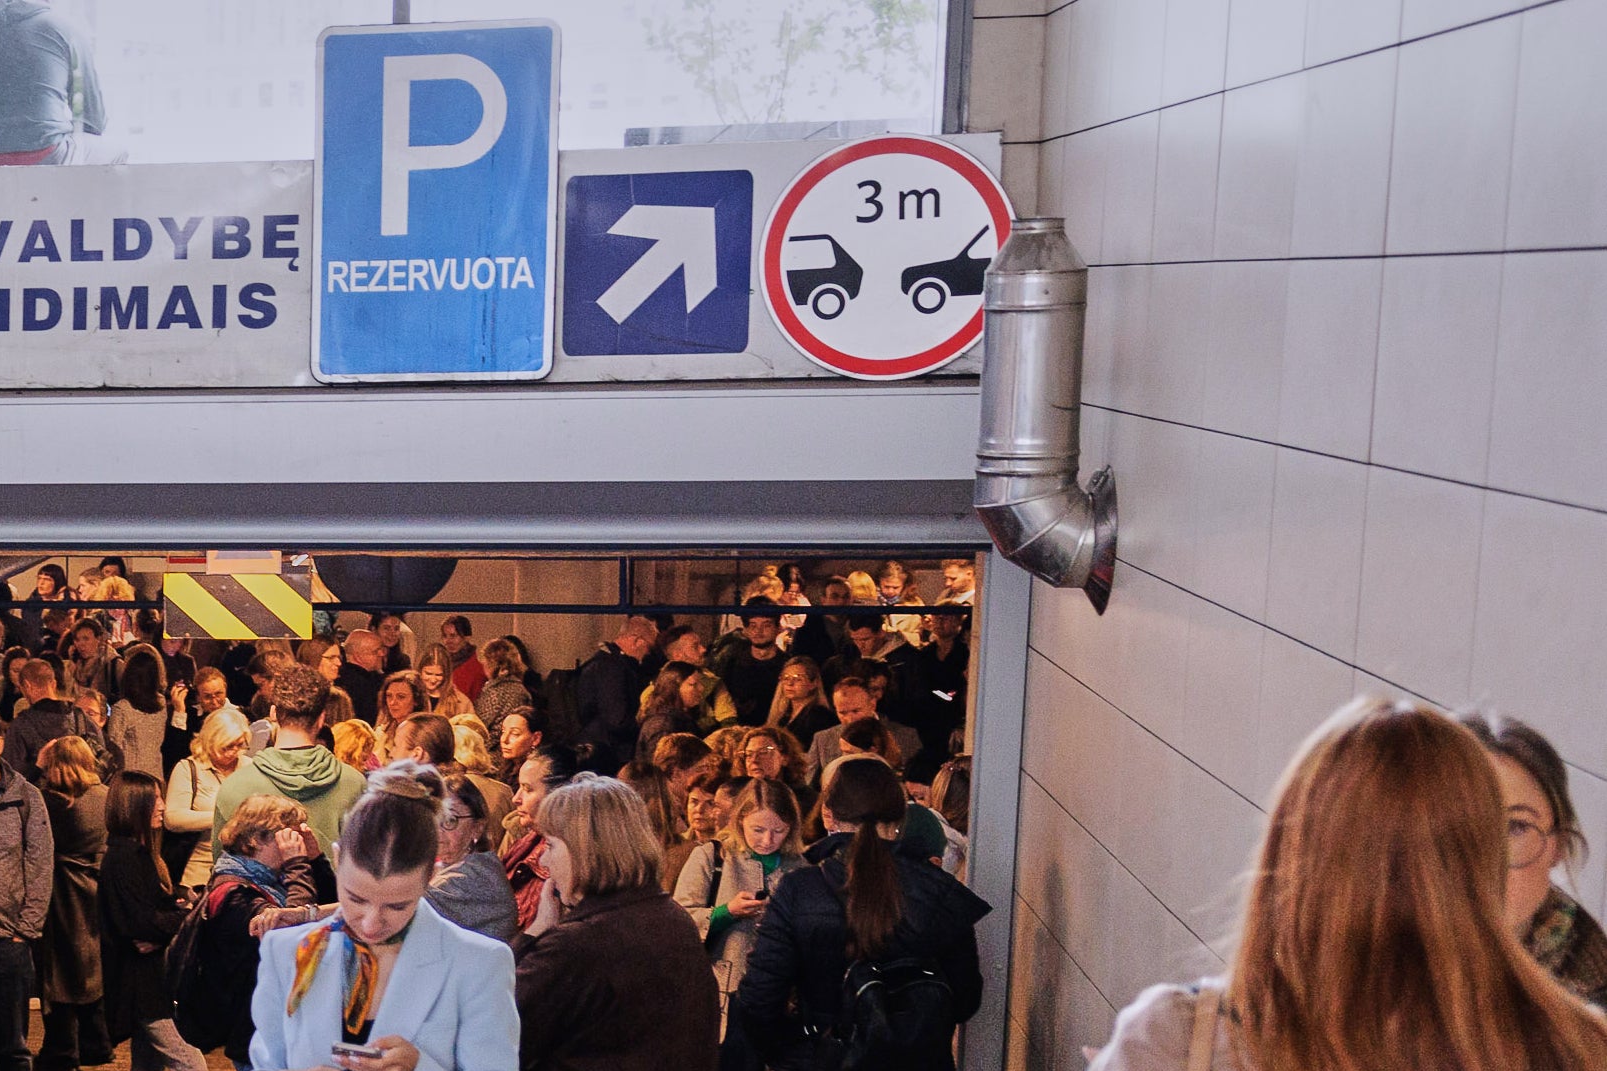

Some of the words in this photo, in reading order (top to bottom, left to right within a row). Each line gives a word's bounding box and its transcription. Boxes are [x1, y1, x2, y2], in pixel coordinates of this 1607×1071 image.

[380, 53, 508, 237] P
[856, 179, 884, 224] 3
[898, 187, 942, 220] m
[327, 256, 535, 293] REZERVUOTA
